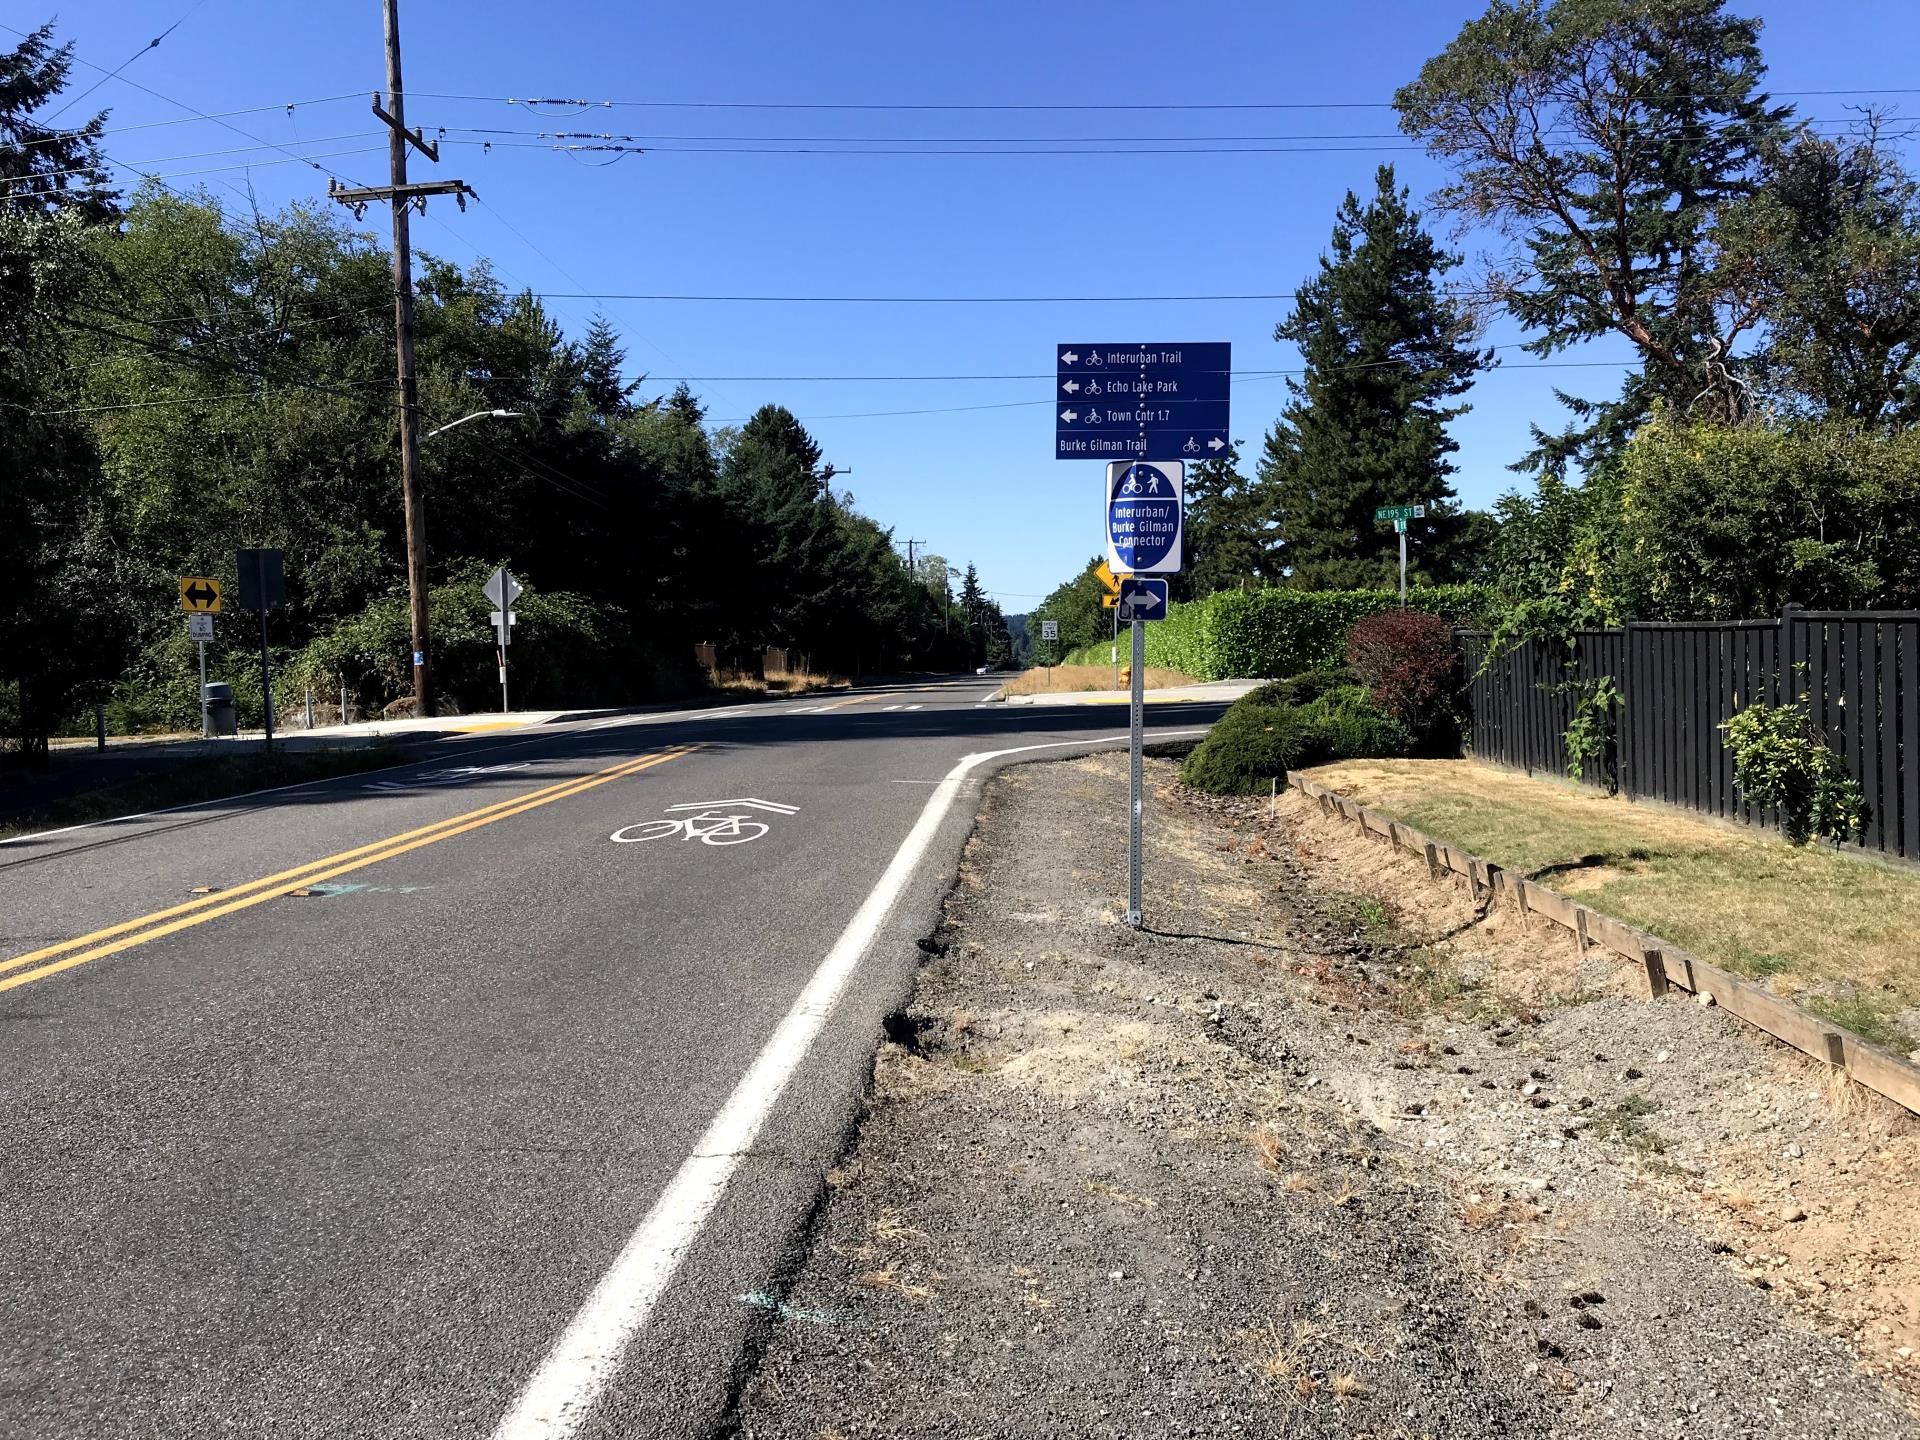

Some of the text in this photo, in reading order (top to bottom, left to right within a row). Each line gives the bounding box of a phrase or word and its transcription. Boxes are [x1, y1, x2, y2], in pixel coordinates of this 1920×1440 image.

[1107, 350, 1182, 364] Interurban Trail
[1107, 380, 1178, 393] Echo Lake Park
[1107, 410, 1170, 422] Town Cntr 1.7
[1060, 438, 1147, 451] Burke Gilman Trail
[1115, 505, 1170, 519] Interurban/
[1403, 507, 1413, 517] ST
[1112, 520, 1174, 533] Burke Gilman
[1119, 535, 1166, 546] Connector
[1043, 630, 1056, 638] 35
